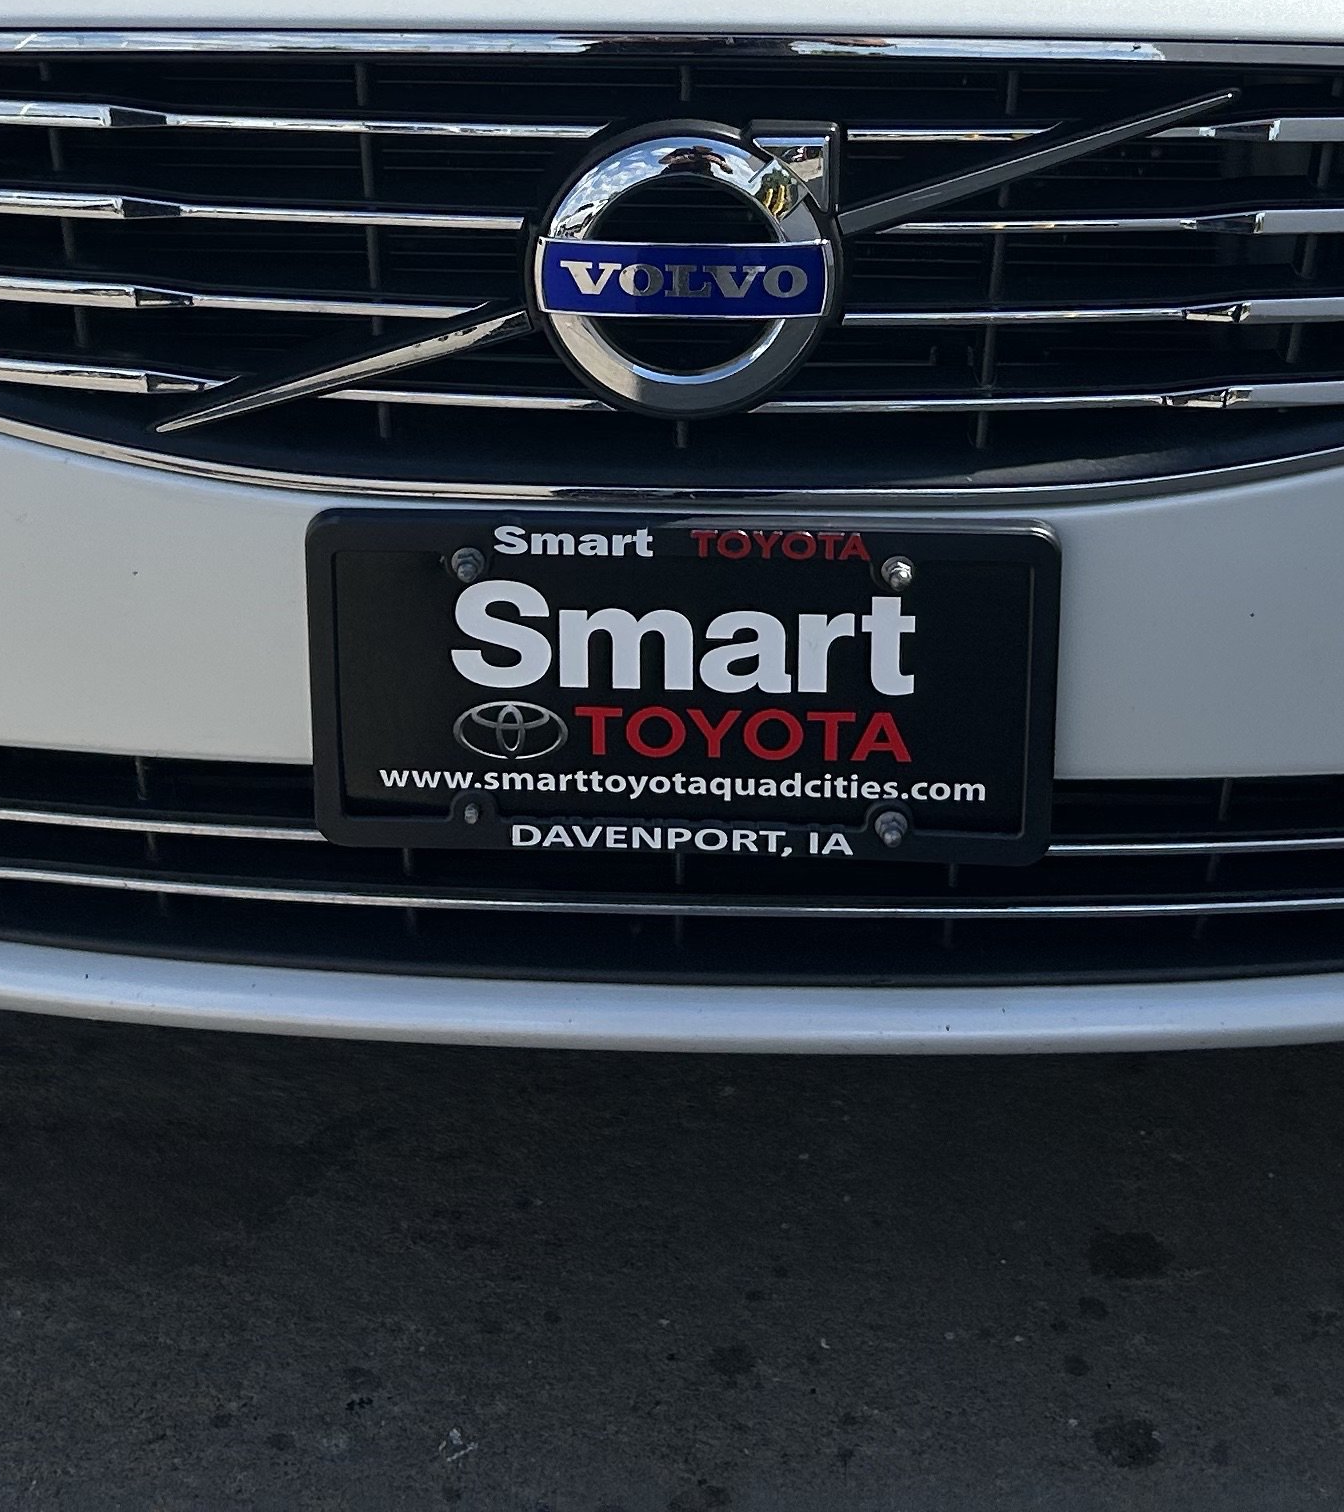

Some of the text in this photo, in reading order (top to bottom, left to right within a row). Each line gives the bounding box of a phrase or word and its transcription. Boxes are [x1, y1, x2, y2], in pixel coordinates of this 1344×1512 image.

[560, 260, 809, 299] VOLVO
[494, 525, 871, 561] Smart TOYOTA
[450, 579, 917, 697] Smart
[575, 705, 913, 763] TOYOTA
[379, 767, 987, 803] www.smarttoyotaquadcities.com
[511, 824, 855, 857] DAVENPORT, IA
